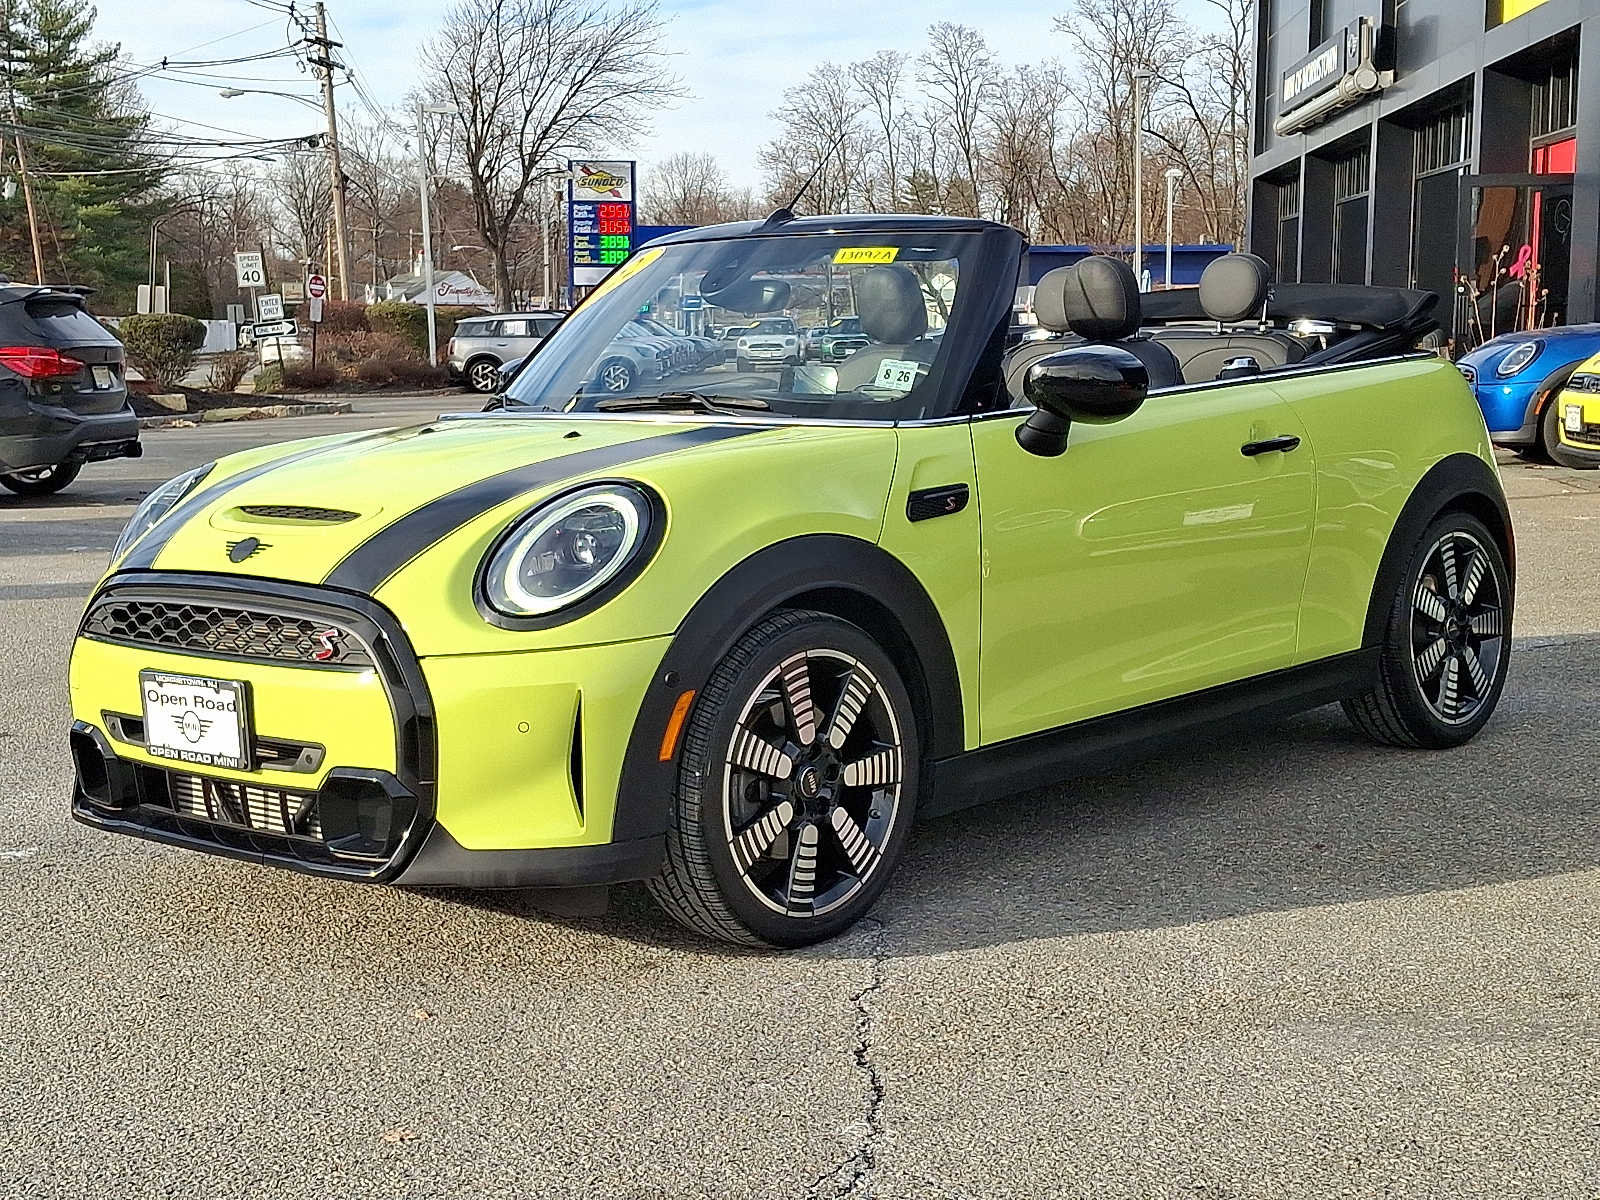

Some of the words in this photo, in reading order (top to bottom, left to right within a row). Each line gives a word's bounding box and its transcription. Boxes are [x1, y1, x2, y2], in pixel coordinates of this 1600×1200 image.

[580, 178, 624, 187] SUNOCO
[242, 271, 260, 282] 40
[261, 298, 279, 306] ENTER
[264, 307, 279, 315] ONLY
[884, 369, 892, 379] 8
[897, 371, 910, 382] 26
[311, 628, 339, 661] S
[147, 690, 188, 706] Open
[194, 695, 237, 712] Road
[150, 746, 179, 759] OPEN
[180, 751, 212, 764] ROAD
[214, 756, 238, 768] MINI
